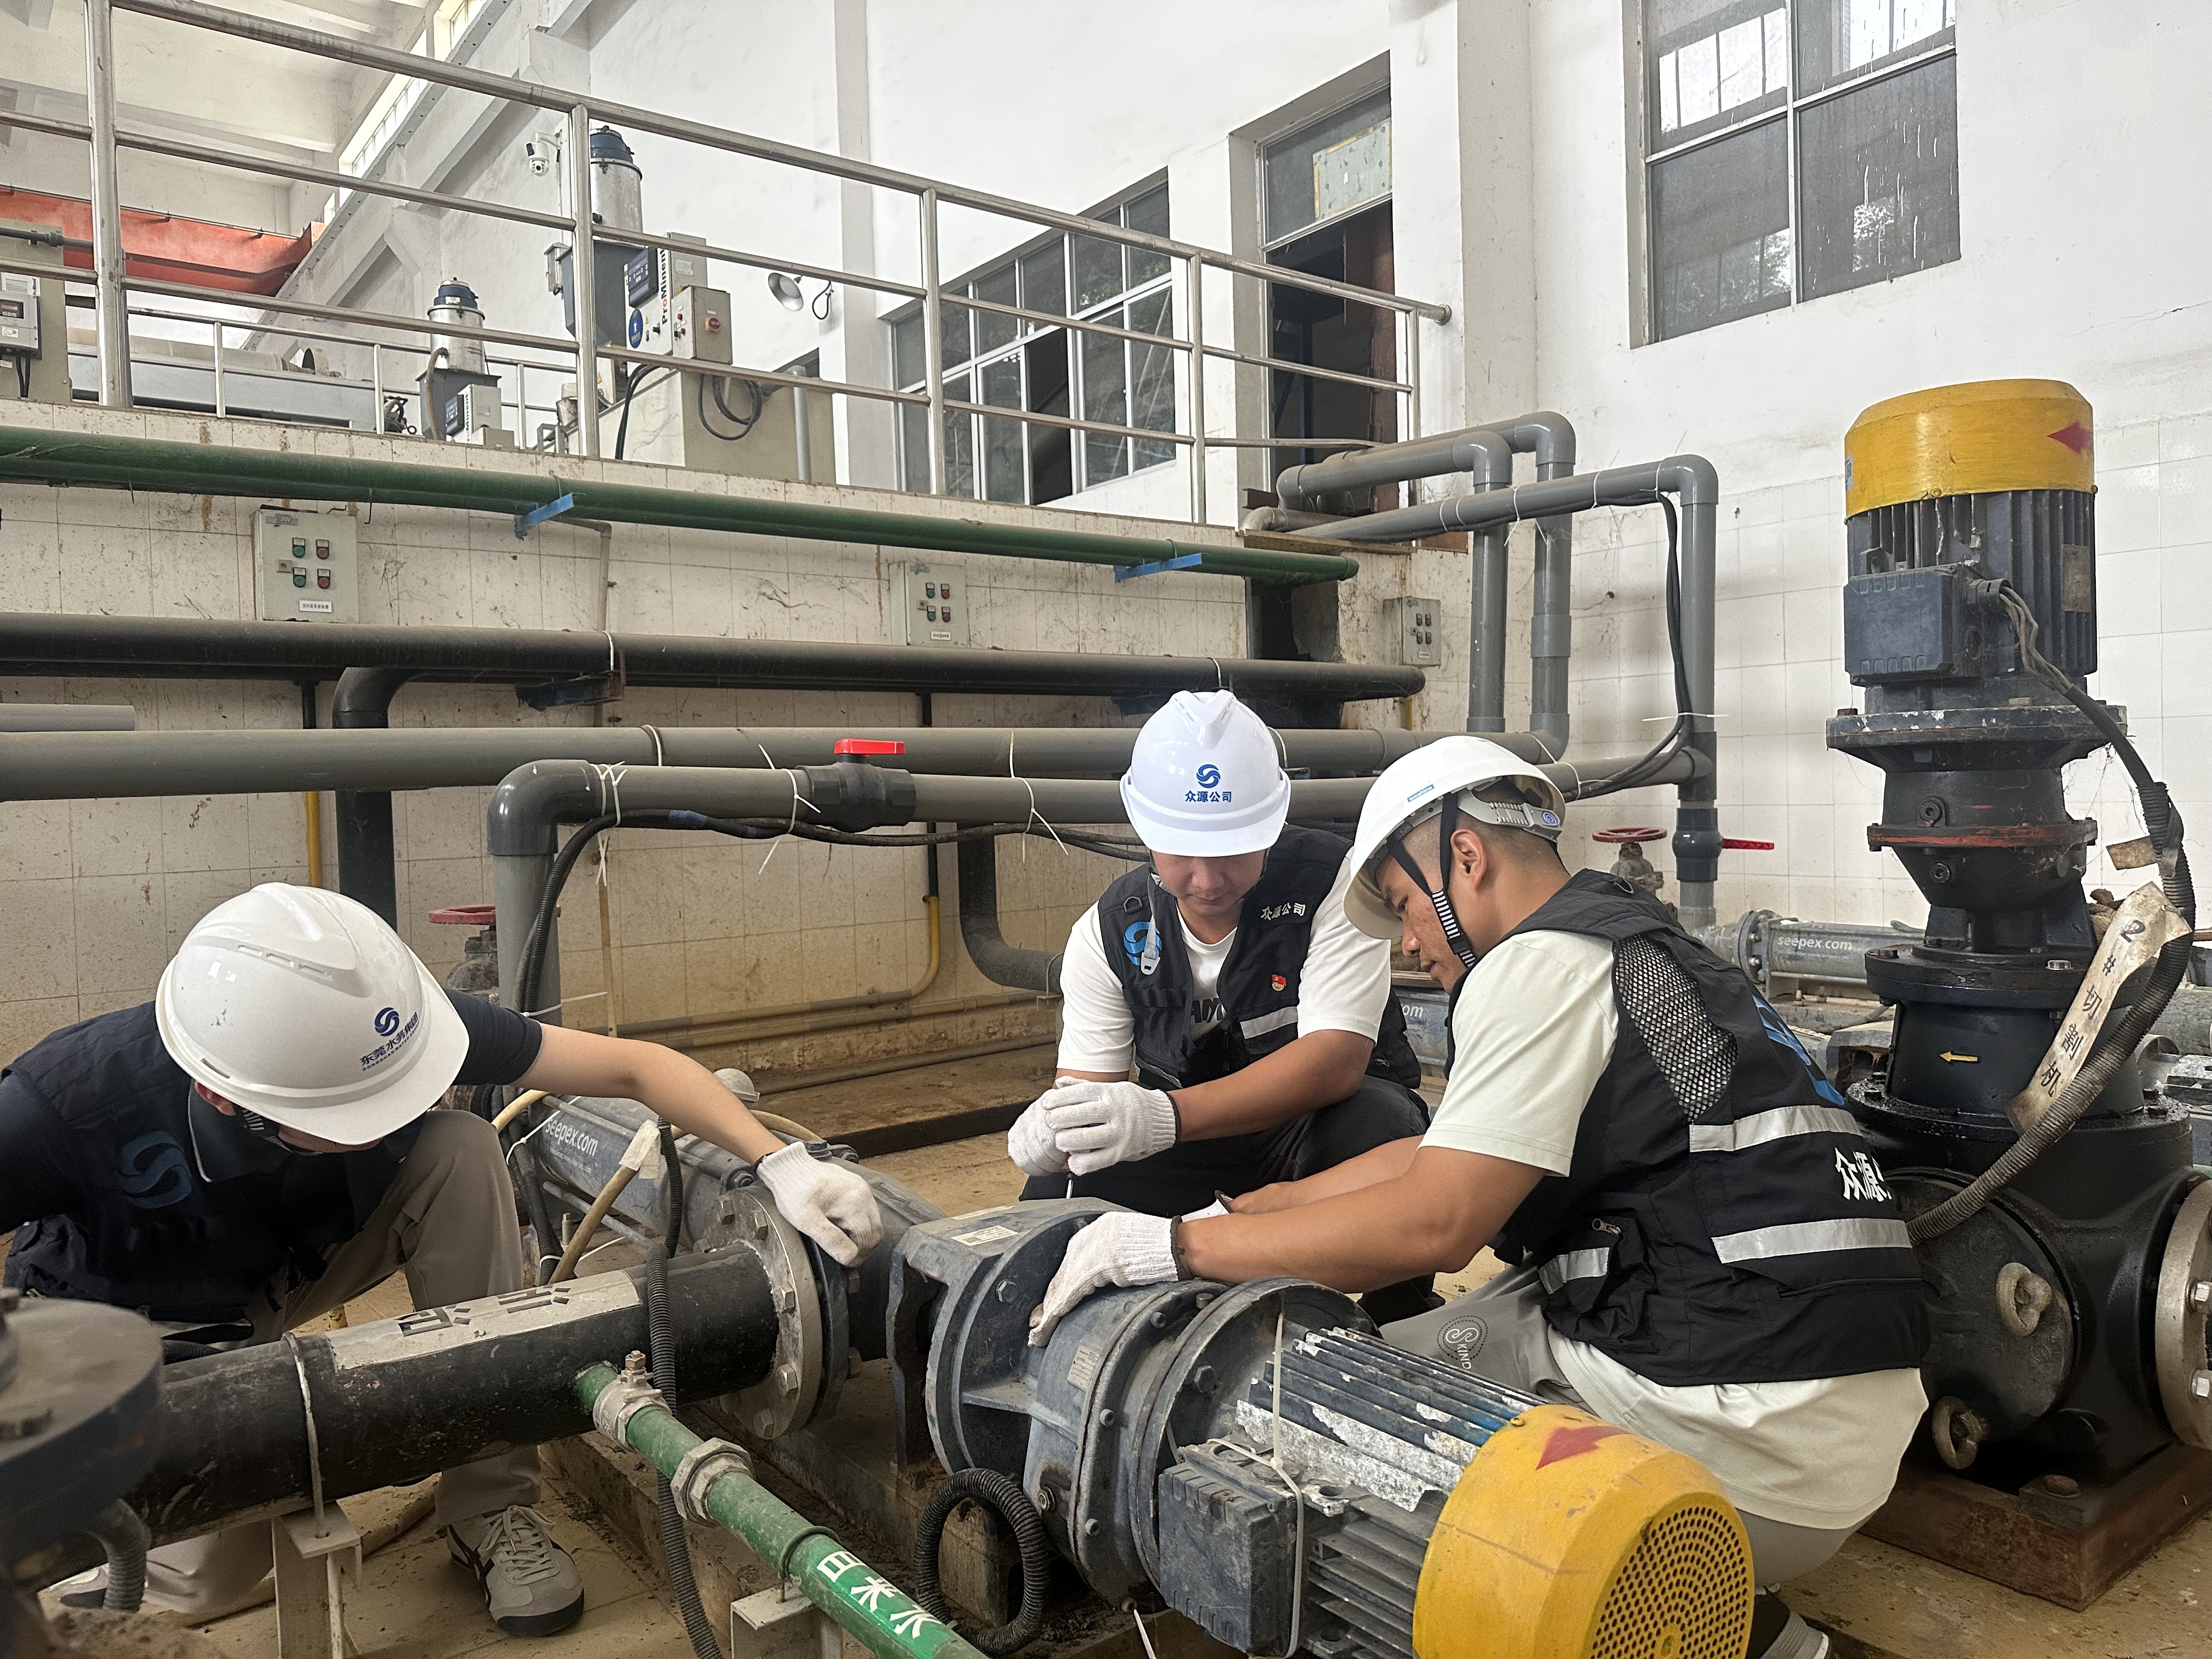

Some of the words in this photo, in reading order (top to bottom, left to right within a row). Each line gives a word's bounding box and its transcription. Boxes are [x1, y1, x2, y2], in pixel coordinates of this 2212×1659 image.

[1185, 790, 1232, 802] 众源公司
[1261, 902, 1306, 921] 众源公司
[1777, 936, 1852, 951] seepex.com
[360, 1012, 418, 1066] 东莞水务集团
[545, 1119, 599, 1156] seepex.com
